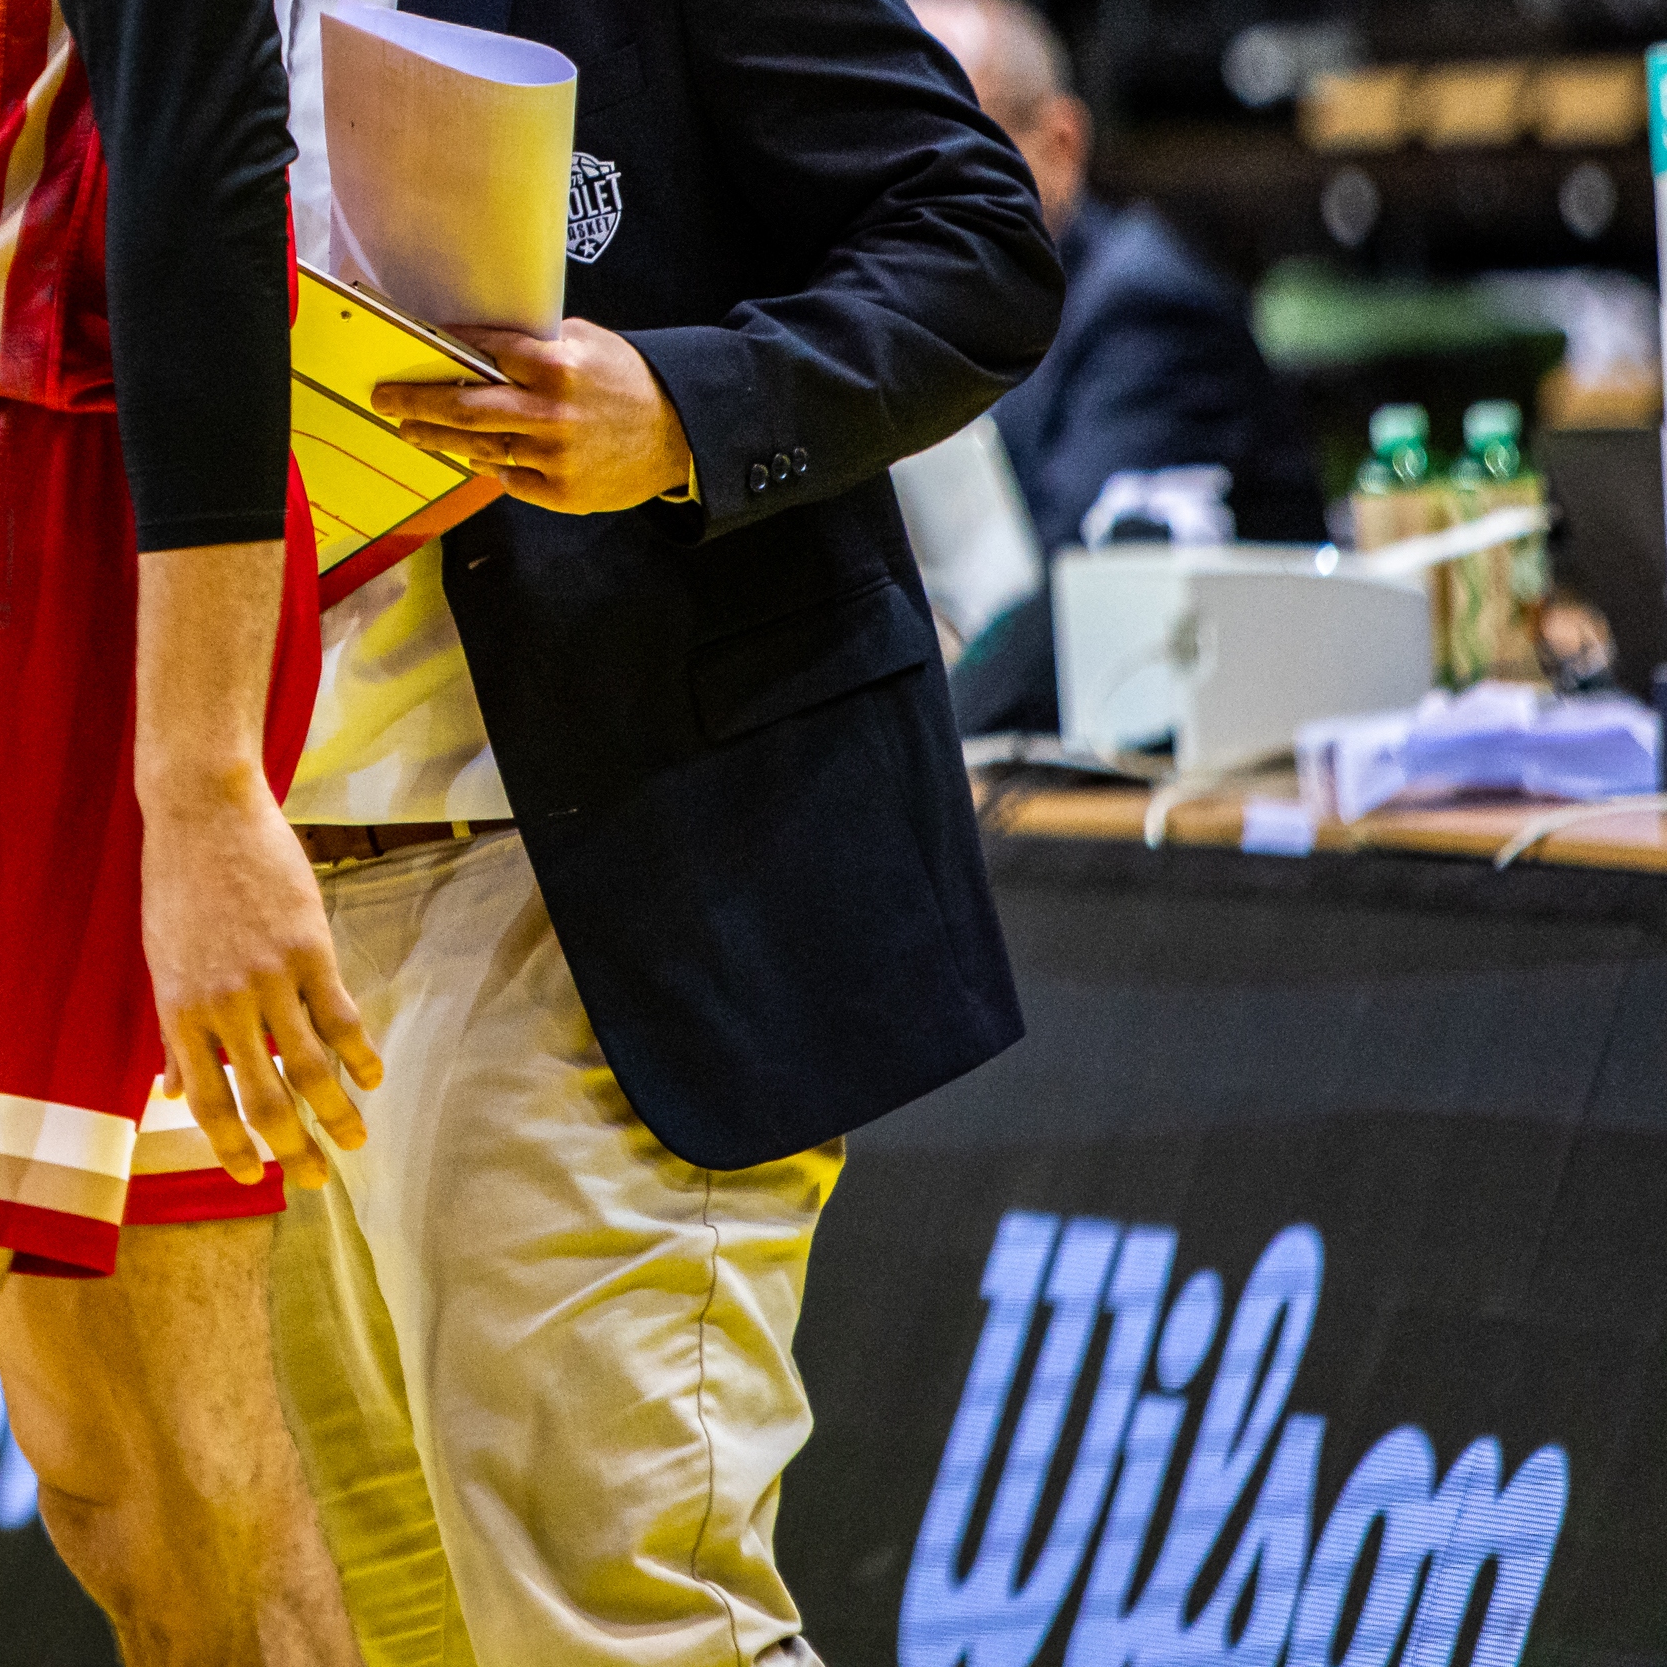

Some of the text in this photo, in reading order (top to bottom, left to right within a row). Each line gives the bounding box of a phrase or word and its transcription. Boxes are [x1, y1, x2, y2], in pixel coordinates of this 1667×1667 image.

[568, 171, 622, 222] OLET
[568, 215, 611, 242] ASKET
[897, 1208, 1571, 1667] Wilson
